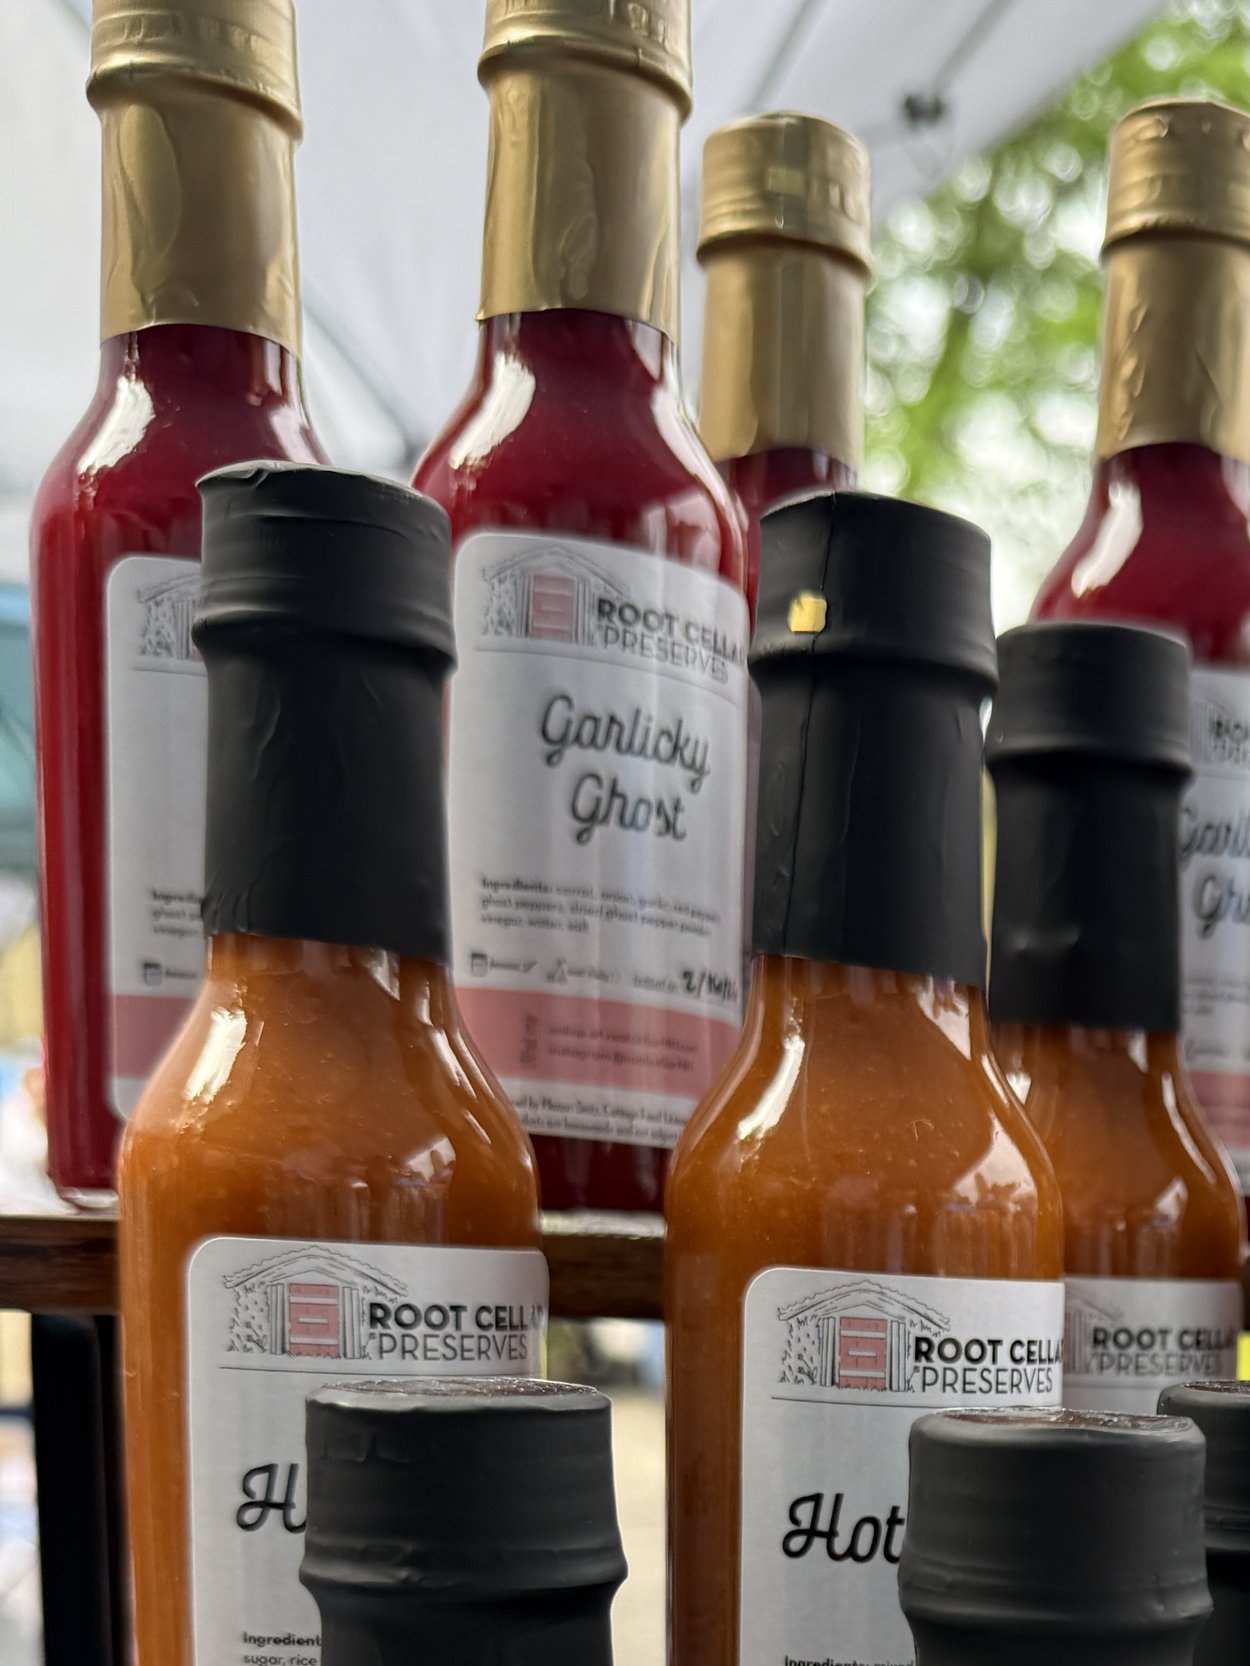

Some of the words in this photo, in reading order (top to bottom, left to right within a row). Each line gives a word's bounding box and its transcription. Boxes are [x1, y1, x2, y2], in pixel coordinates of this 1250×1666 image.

[597, 597, 679, 636] ROOT
[541, 694, 710, 794] Garlicky
[571, 773, 686, 844] Ghost
[369, 1302, 466, 1331] ROOT
[379, 1332, 528, 1361] PRESERVES
[914, 1337, 1003, 1365] ROOT
[1009, 1338, 1064, 1365] CELLA
[1092, 1327, 1173, 1350] ROOT
[922, 1367, 1053, 1394] PRESERVES
[782, 1493, 905, 1563] Hot
[243, 1632, 321, 1648] Ingredient
[243, 1655, 287, 1666] sugar,
[290, 1655, 318, 1666] rice
